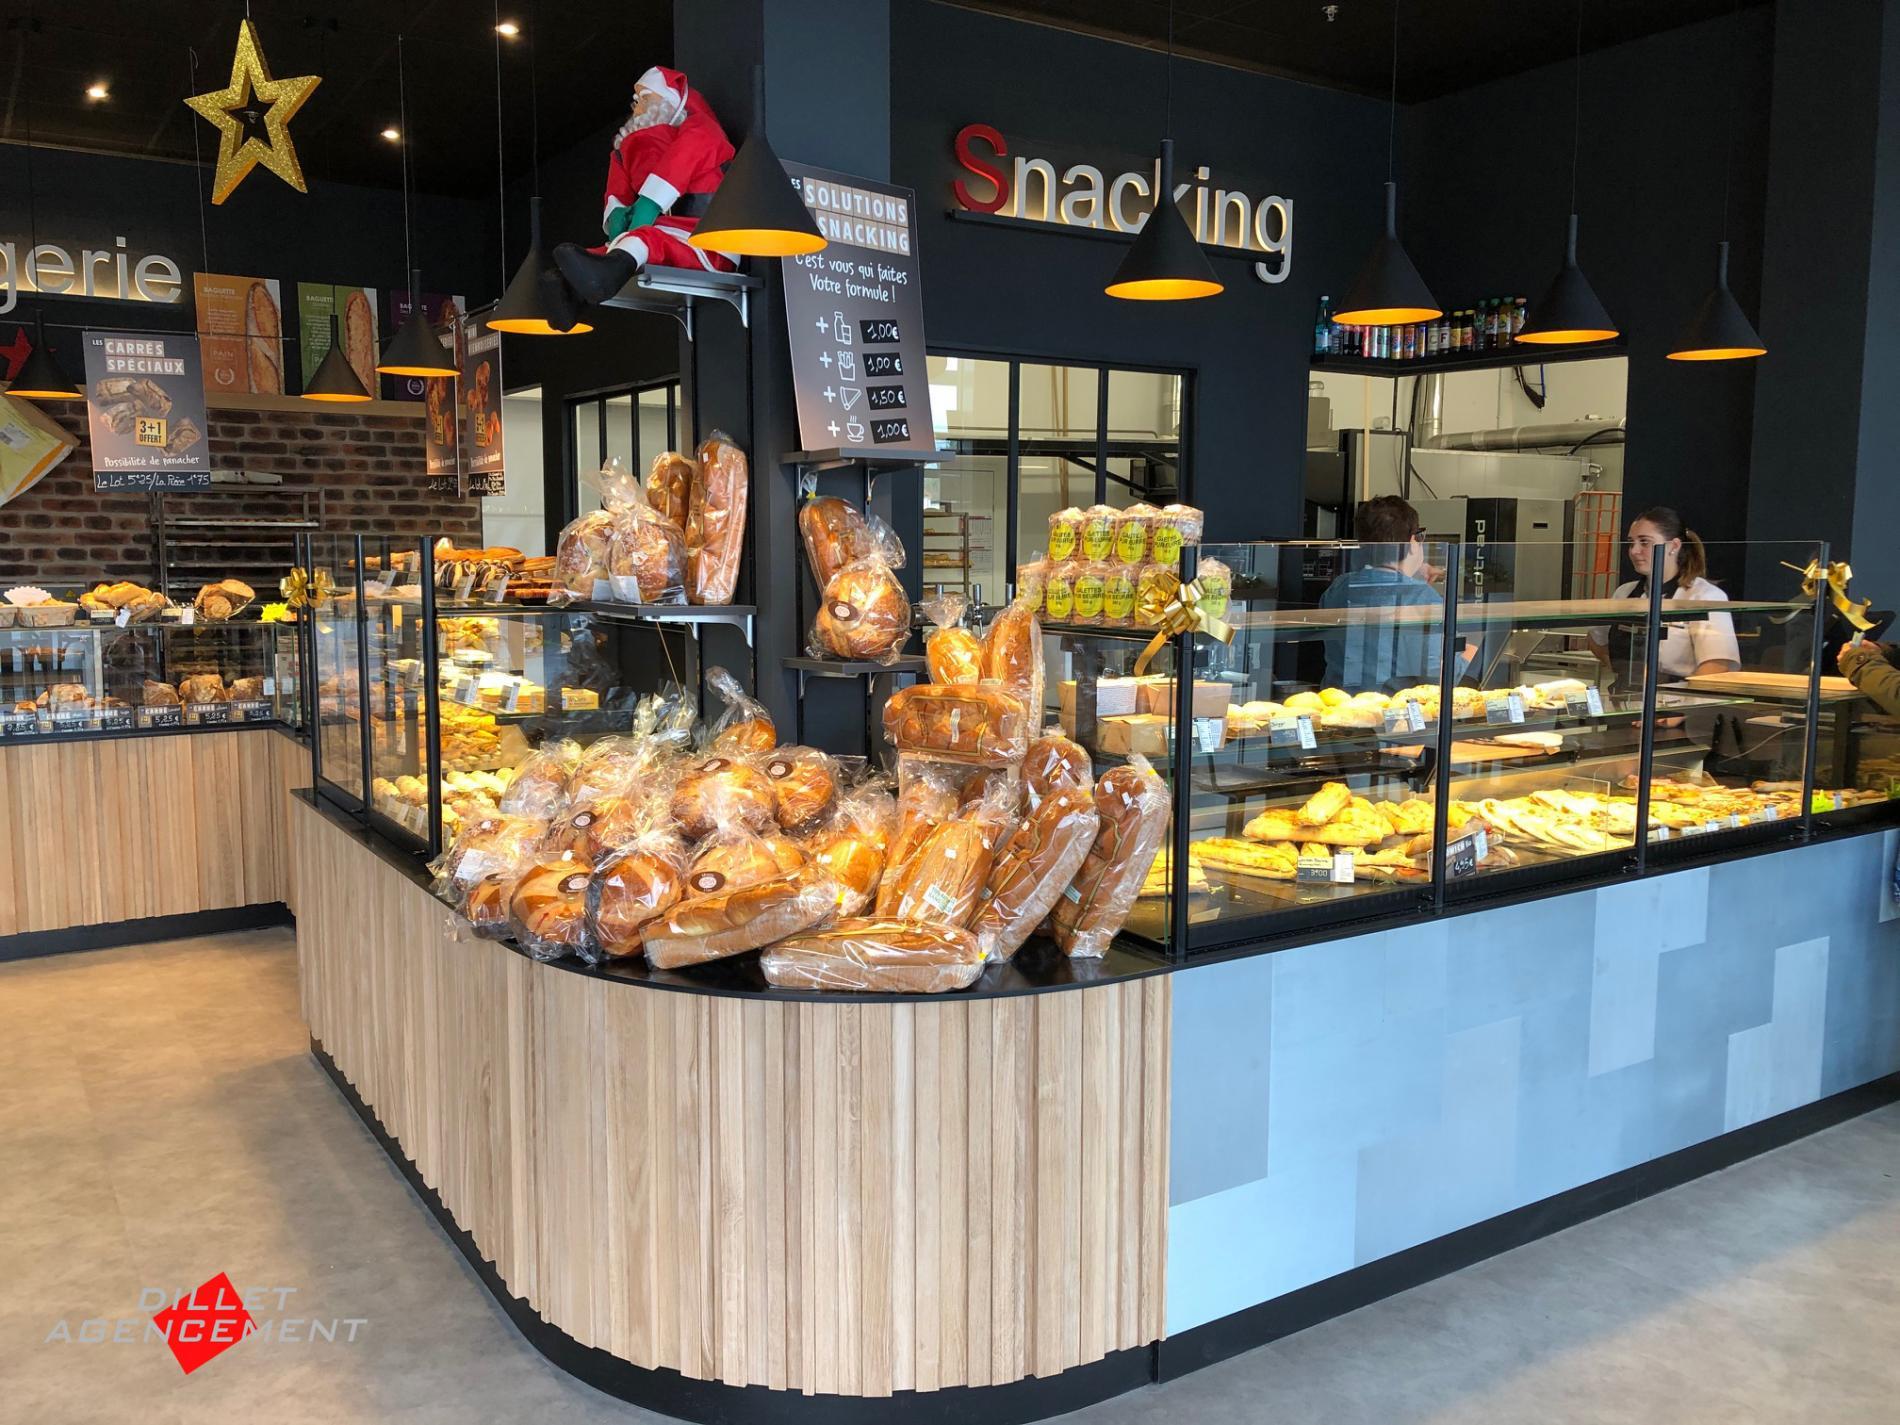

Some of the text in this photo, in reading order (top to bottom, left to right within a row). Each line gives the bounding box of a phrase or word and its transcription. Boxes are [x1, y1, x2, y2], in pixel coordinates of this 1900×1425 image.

[804, 184, 907, 223] SOLUTIONS
[818, 216, 909, 251] SNACKING
[795, 253, 907, 285] C'est vous qui faites
[810, 273, 841, 294] Votre
[845, 279, 888, 302] formule
[105, 341, 163, 355] CARRÉS
[107, 358, 184, 373] SPÉCIAUX
[140, 420, 161, 435] 3+1
[139, 434, 161, 443] OFFERT
[104, 454, 200, 467] Possibilité de panacher
